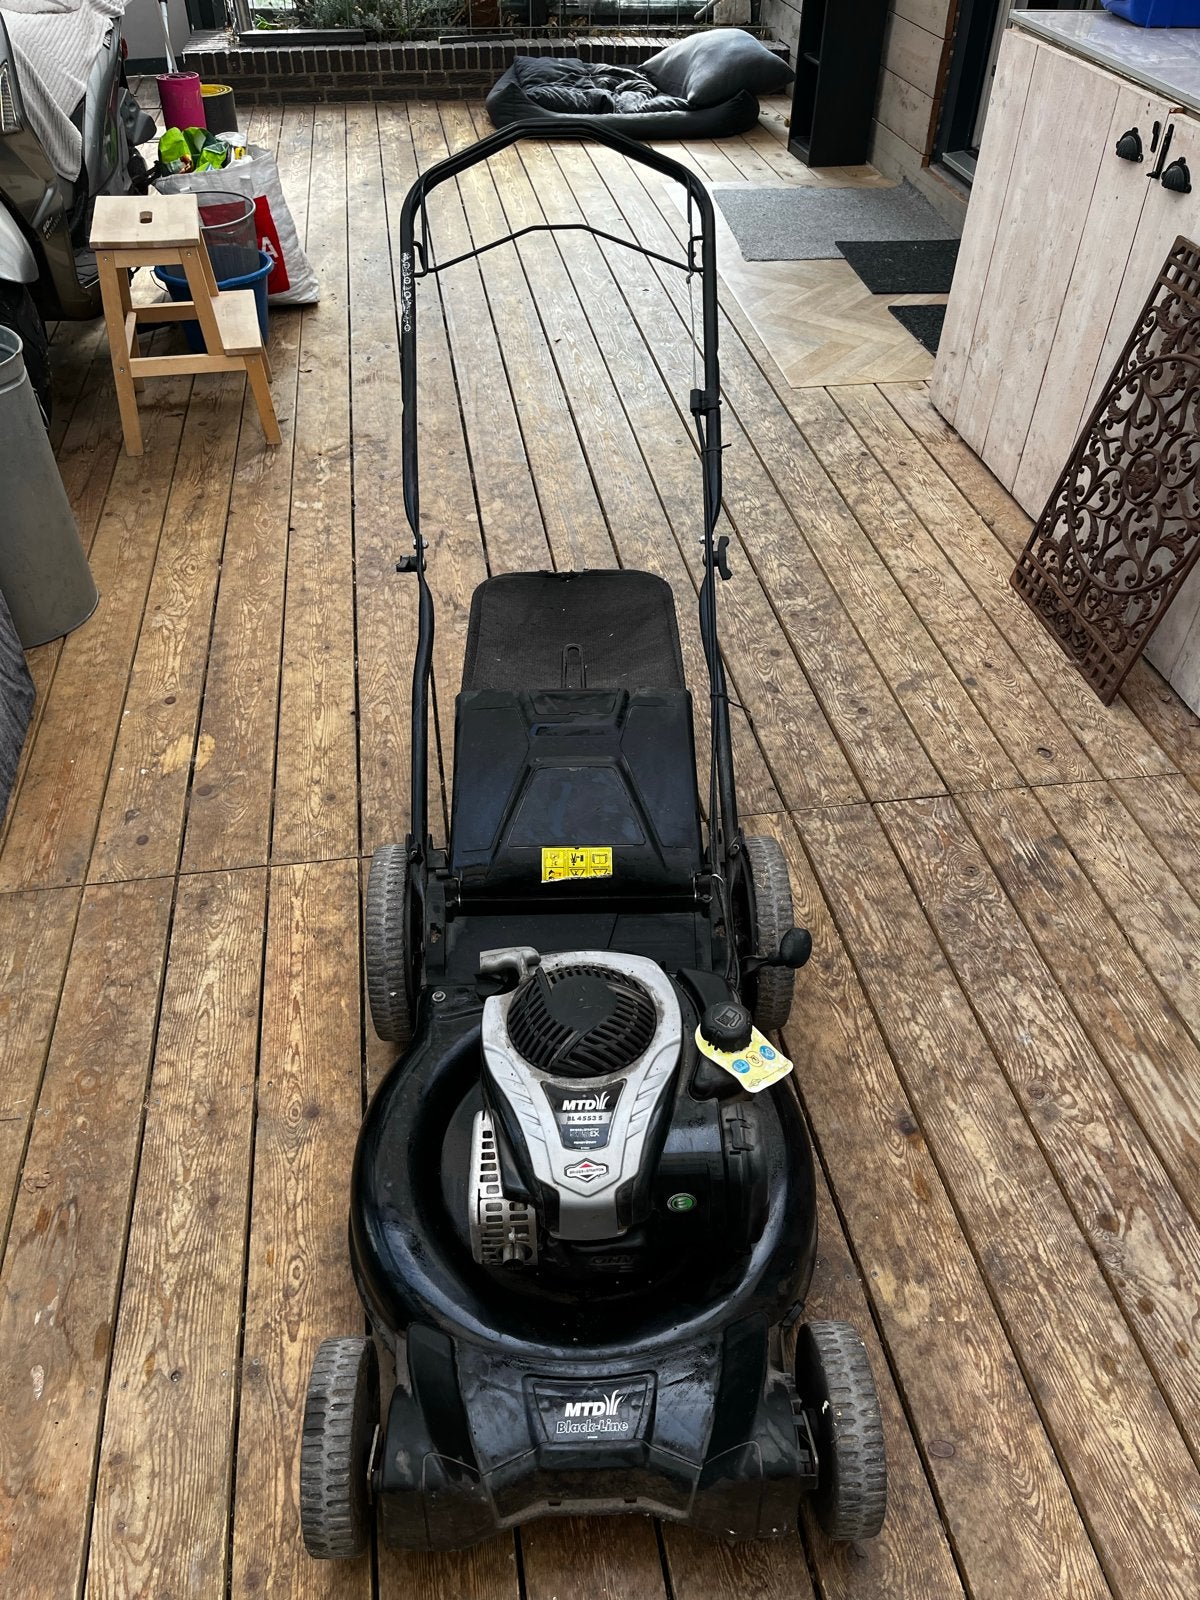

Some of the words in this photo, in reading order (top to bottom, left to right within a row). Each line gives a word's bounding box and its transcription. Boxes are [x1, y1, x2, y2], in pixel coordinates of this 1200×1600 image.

[562, 1099, 596, 1111] MTD
[564, 1401, 606, 1418] MTD
[556, 1419, 629, 1434] Black-Line
